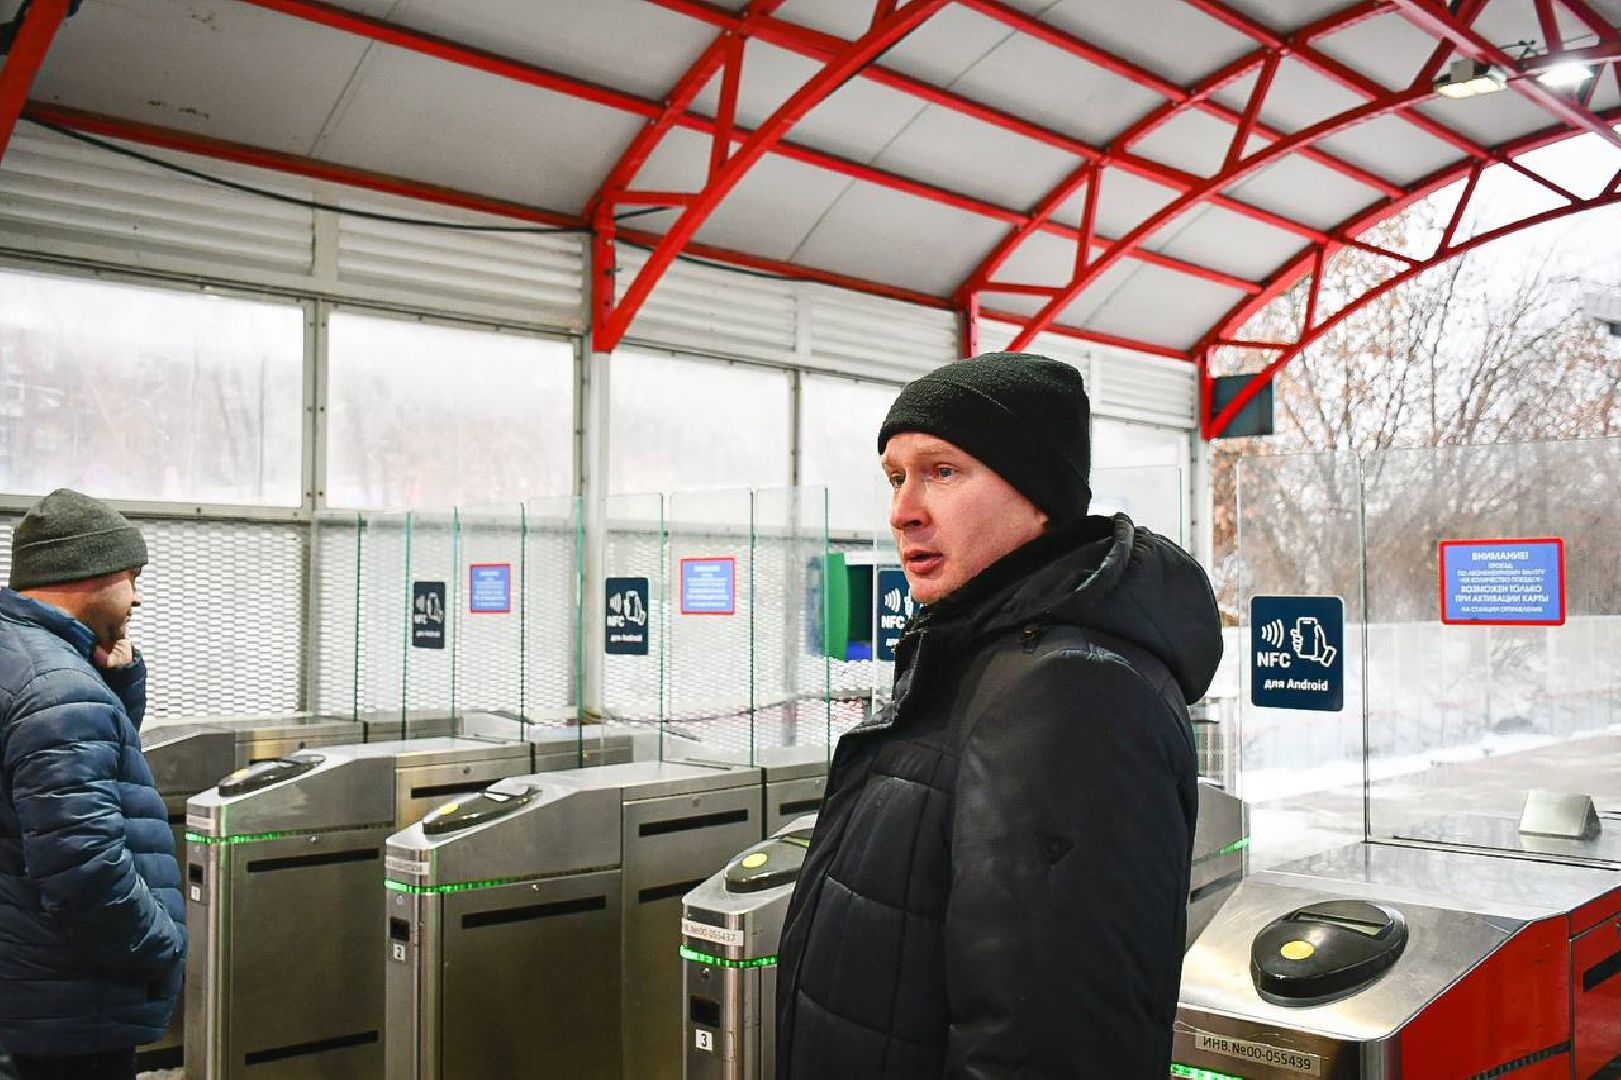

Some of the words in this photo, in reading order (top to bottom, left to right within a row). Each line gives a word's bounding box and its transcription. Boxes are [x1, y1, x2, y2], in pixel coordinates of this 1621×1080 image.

[1471, 551, 1528, 560] ВНИМАНИЕ!
[1472, 595, 1520, 603] АКТИВАЦИИ
[881, 616, 905, 629] NFC
[1257, 652, 1290, 668] NFC
[1264, 679, 1285, 690] для
[1287, 679, 1328, 691] Android
[701, 1033, 707, 1047] 3
